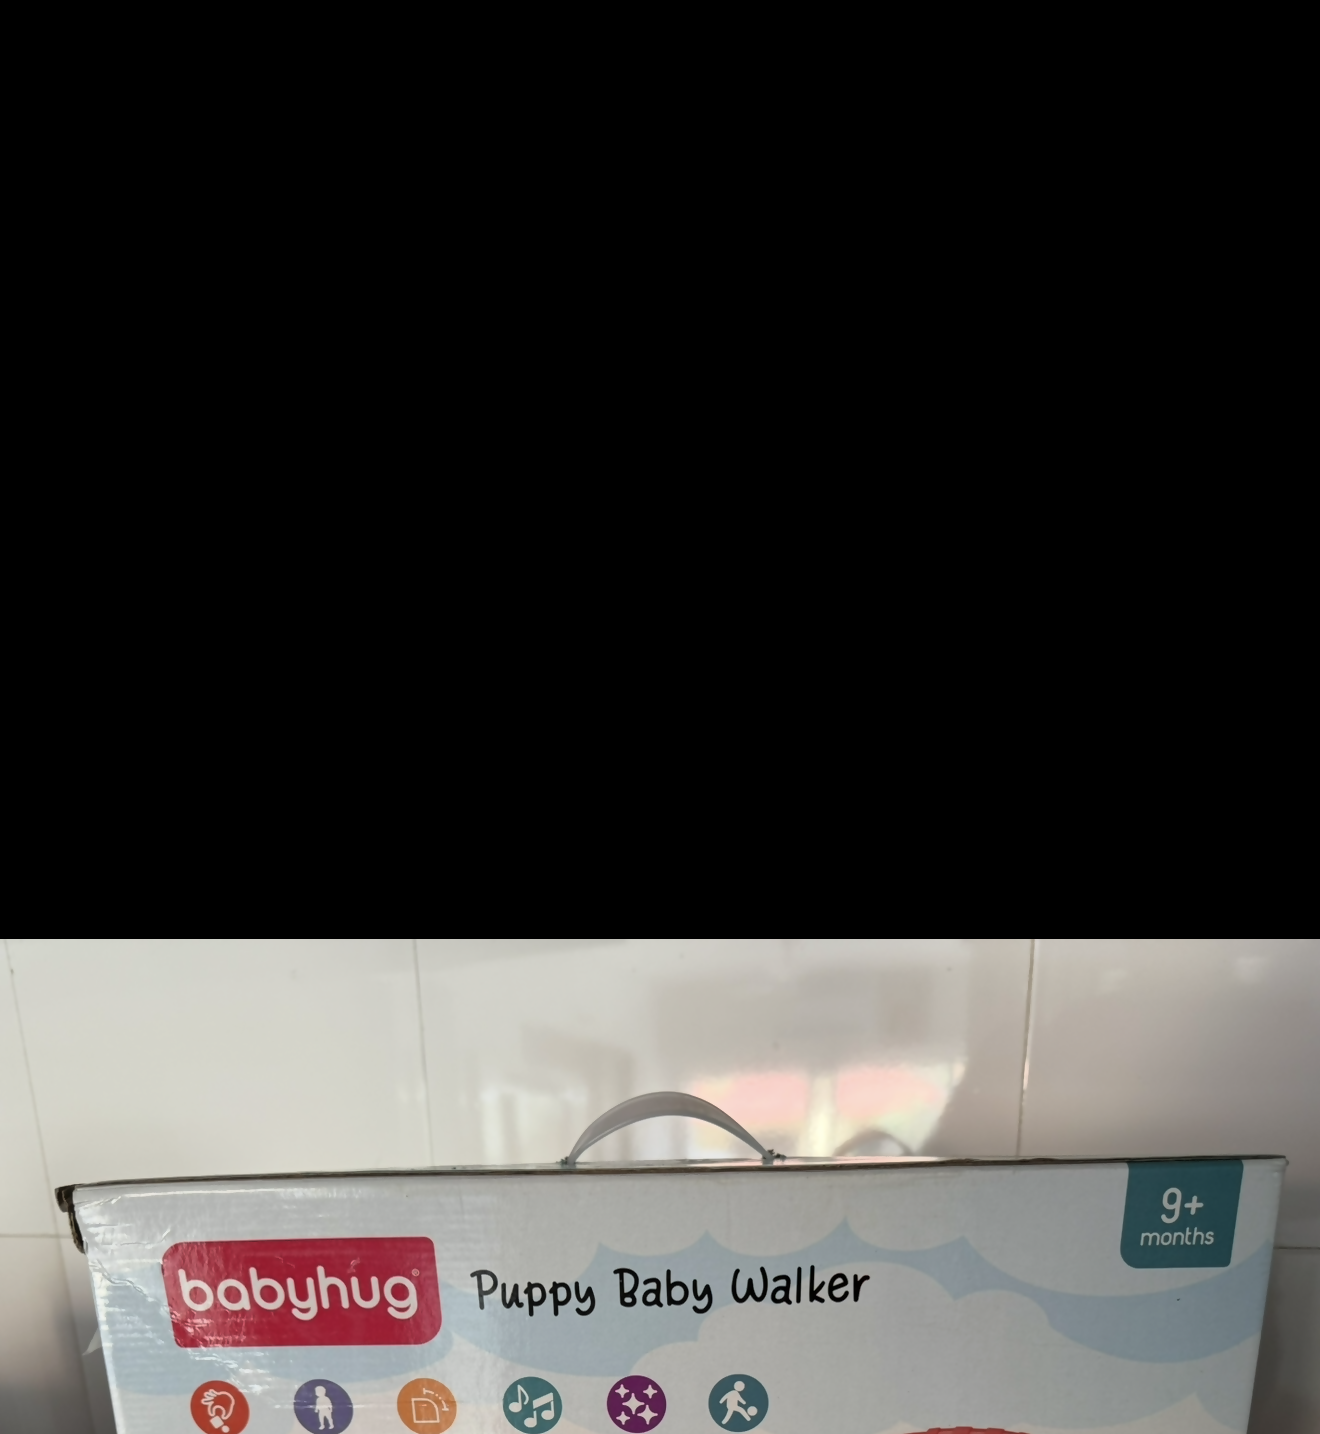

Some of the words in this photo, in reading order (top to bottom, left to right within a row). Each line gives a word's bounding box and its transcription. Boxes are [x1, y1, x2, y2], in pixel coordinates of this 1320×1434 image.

[1160, 1187, 1204, 1224] 9+
[1140, 1227, 1215, 1246] months
[469, 1268, 596, 1317] Puppy
[612, 1266, 713, 1315] Baby
[730, 1264, 870, 1305] Walker
